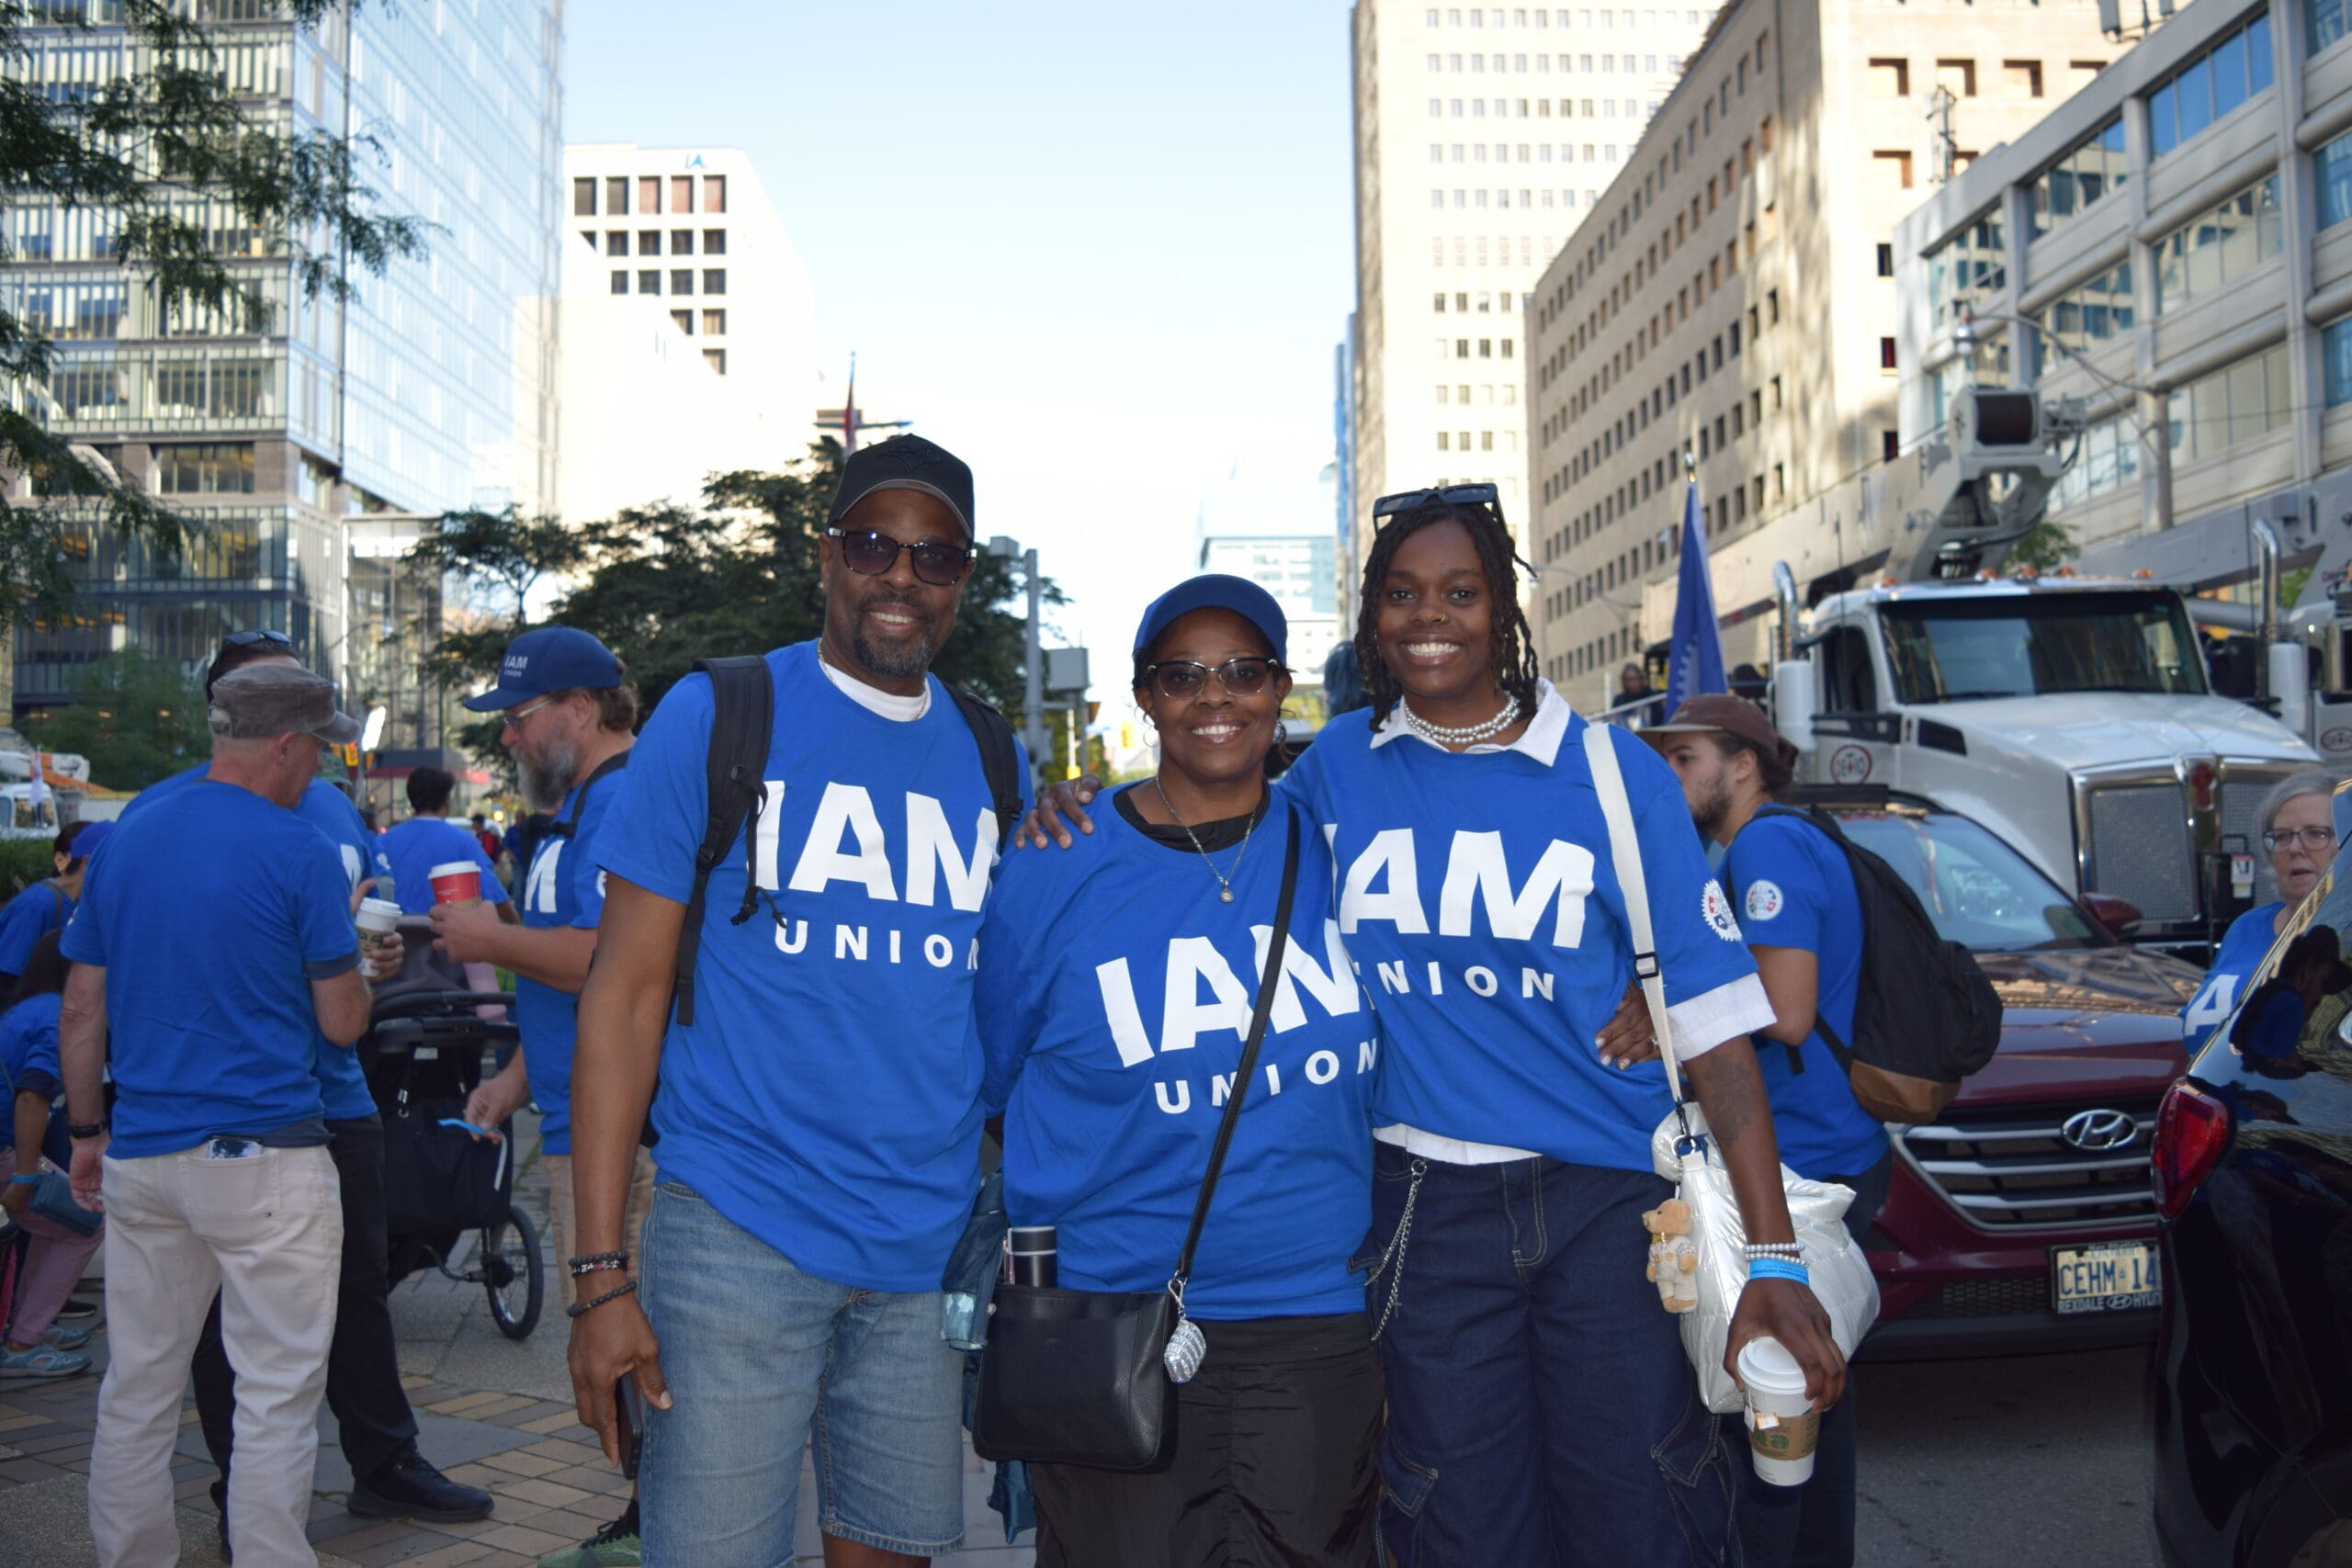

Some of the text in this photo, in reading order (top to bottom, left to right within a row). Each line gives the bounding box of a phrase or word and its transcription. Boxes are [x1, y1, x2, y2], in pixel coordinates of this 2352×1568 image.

[504, 655, 529, 670] IAM
[746, 780, 1001, 912] IAM
[1323, 822, 1595, 949] AM
[1095, 918, 1360, 1067] IAM
[1352, 960, 1555, 1010] NION
[2060, 1260, 2116, 1294] CEHM
[2058, 1296, 2106, 1314] REXDALE
